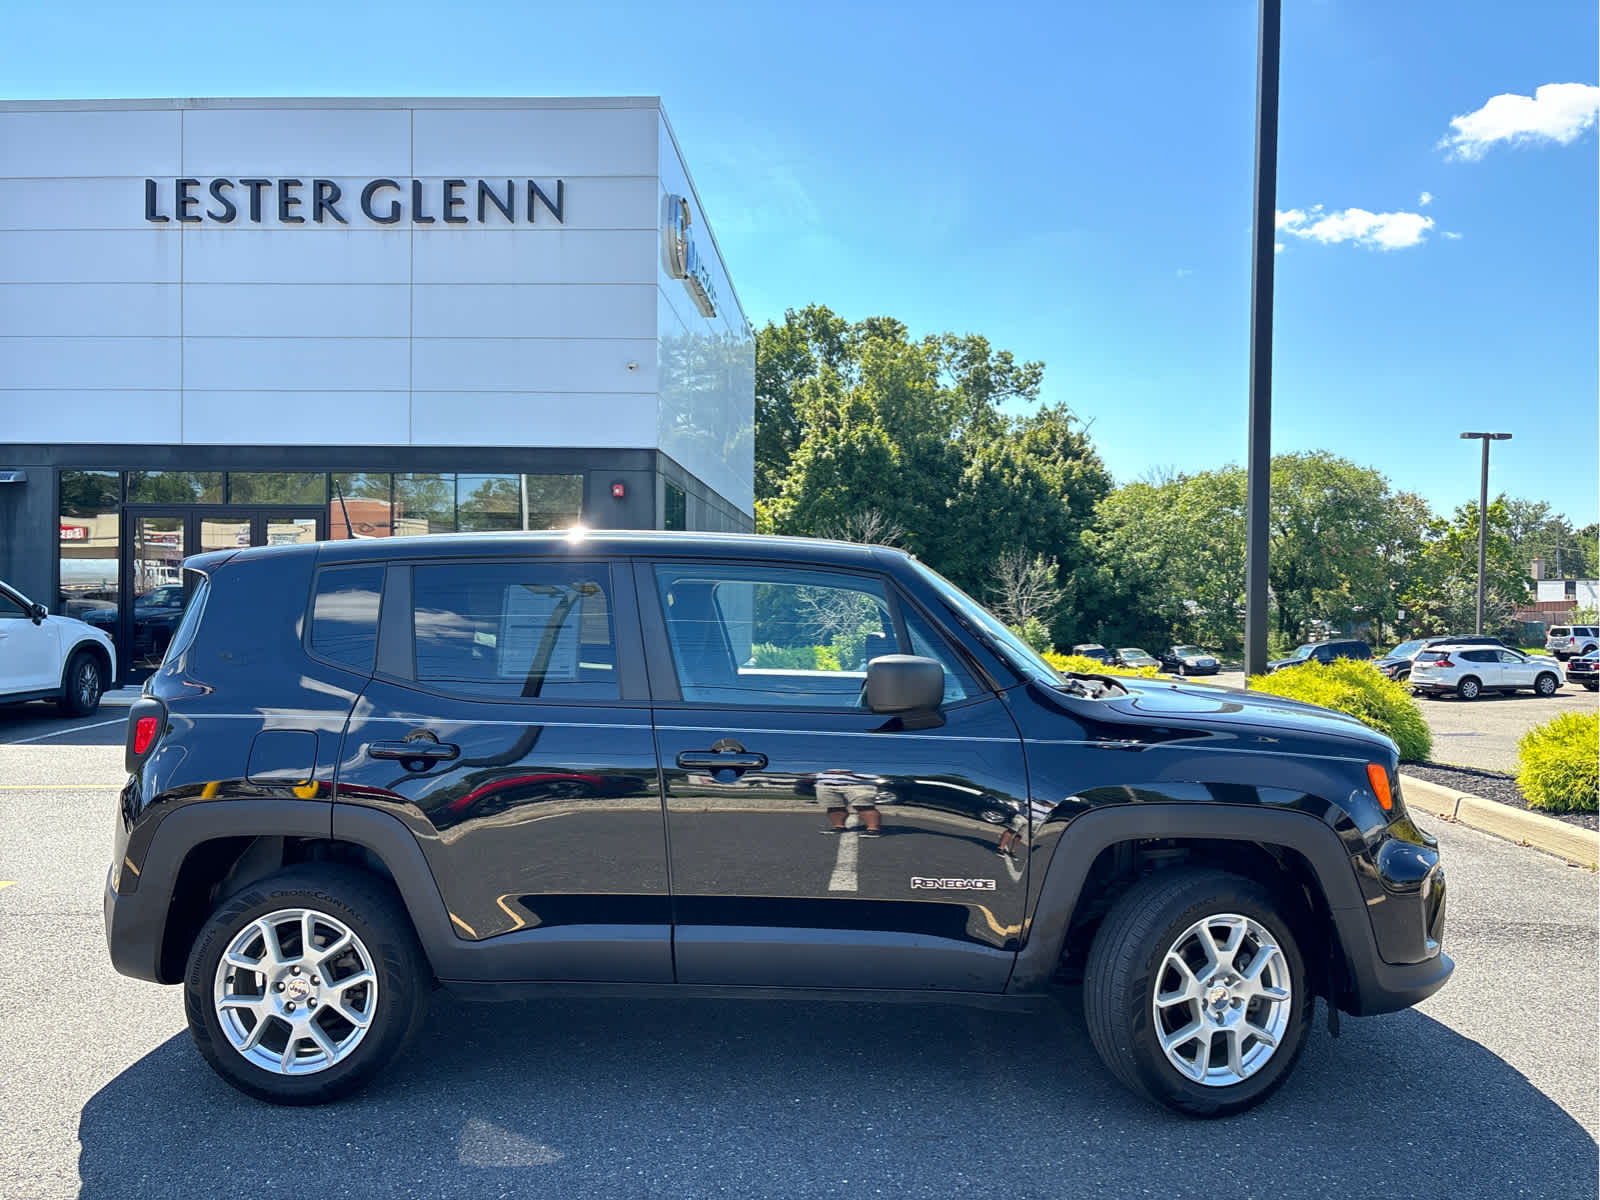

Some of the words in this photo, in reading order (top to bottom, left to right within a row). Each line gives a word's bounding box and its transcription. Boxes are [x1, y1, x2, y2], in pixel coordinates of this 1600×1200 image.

[145, 178, 348, 224] LESTER
[360, 178, 564, 224] GLENN
[911, 877, 996, 890] RENEGADE
